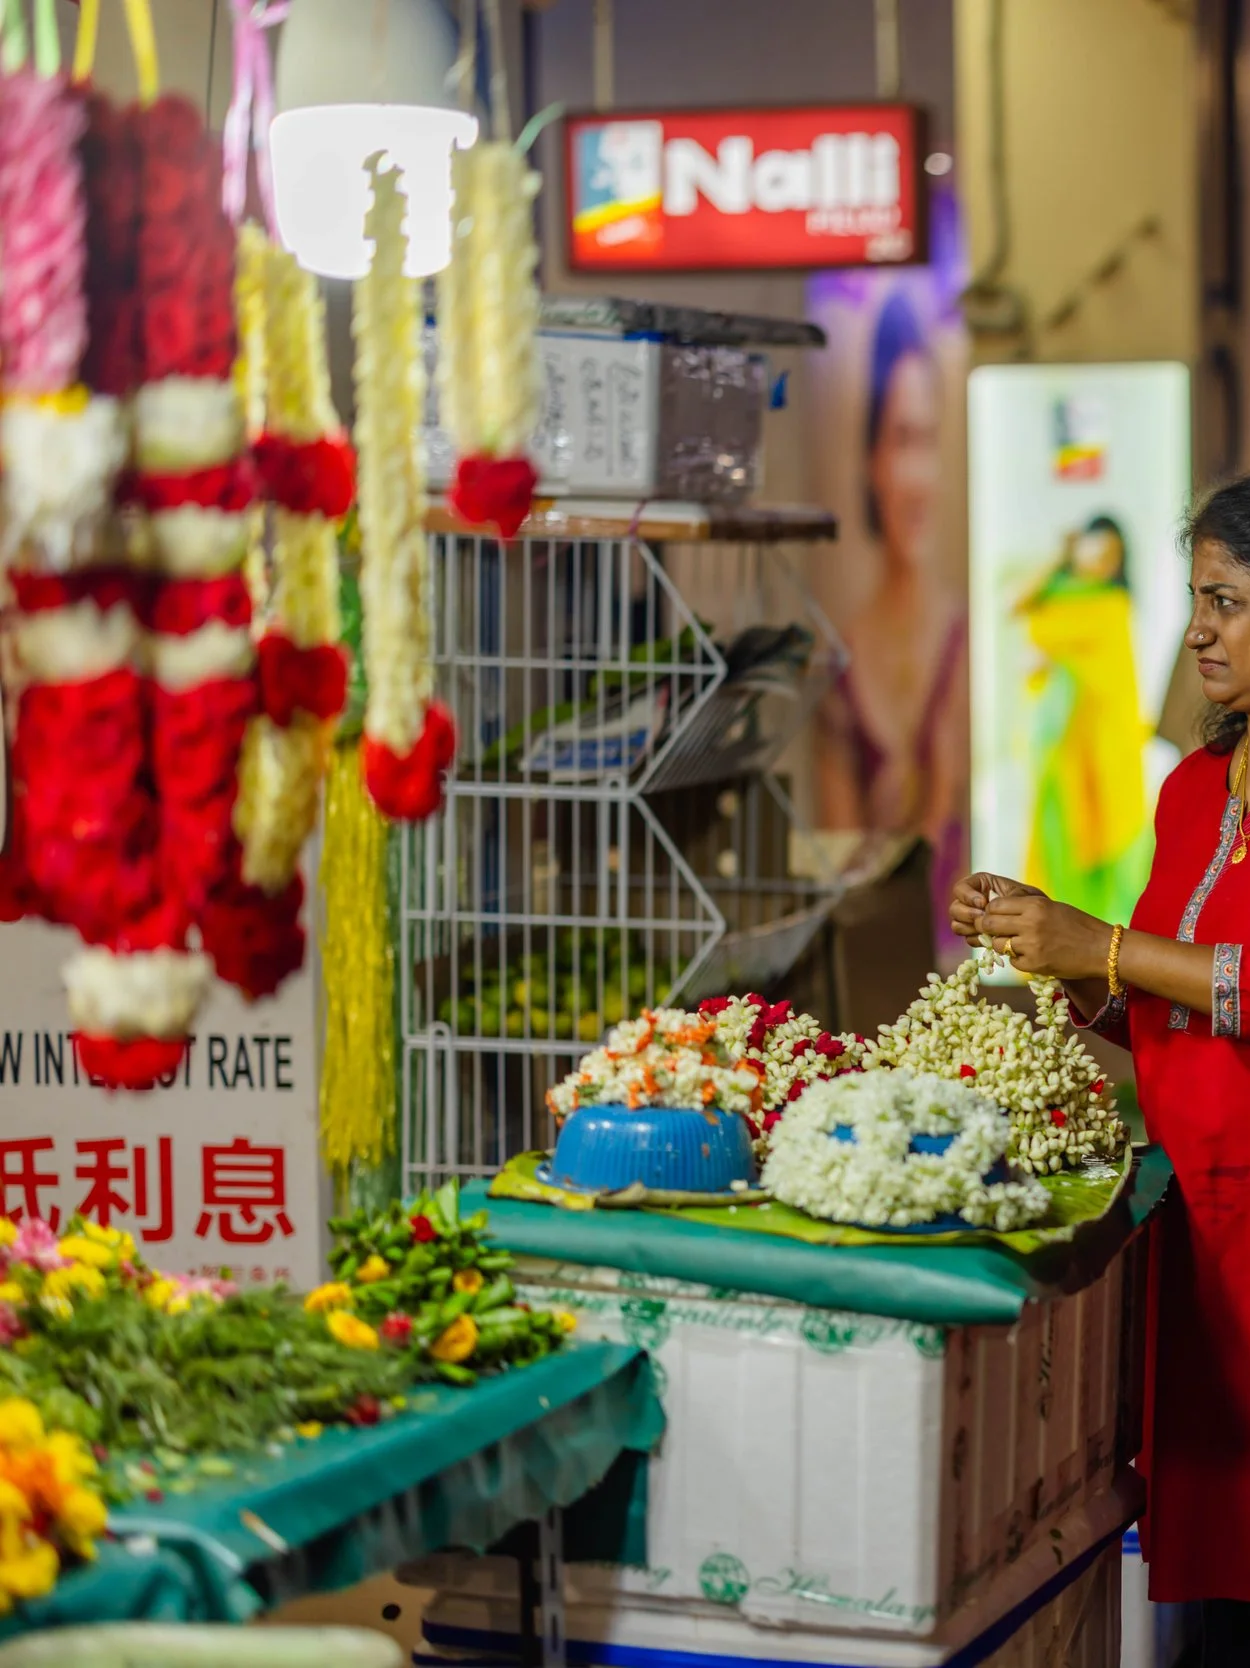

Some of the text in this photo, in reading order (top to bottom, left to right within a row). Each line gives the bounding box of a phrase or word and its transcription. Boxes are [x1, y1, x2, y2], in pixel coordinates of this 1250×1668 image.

[663, 131, 901, 217] Nalli
[34, 1031, 197, 1088] INTT
[207, 1035, 294, 1090] RATE
